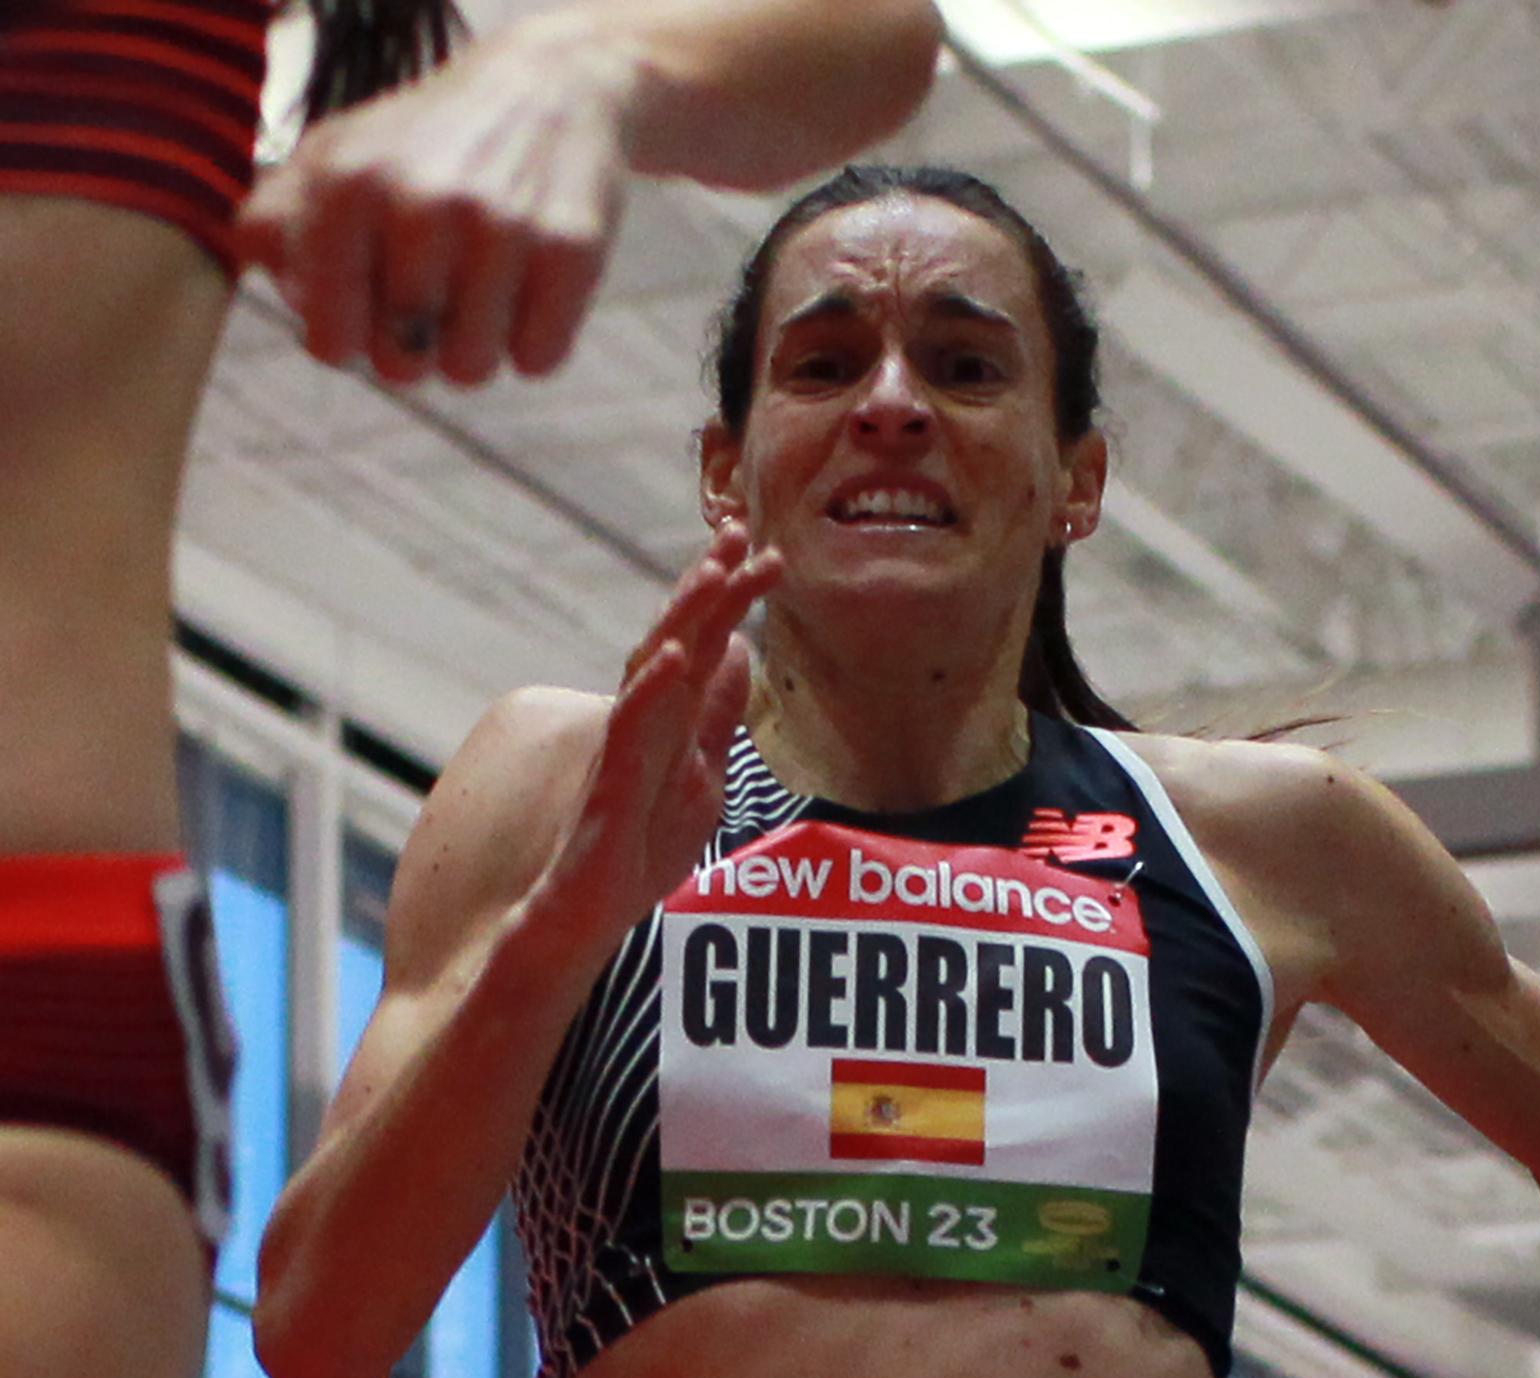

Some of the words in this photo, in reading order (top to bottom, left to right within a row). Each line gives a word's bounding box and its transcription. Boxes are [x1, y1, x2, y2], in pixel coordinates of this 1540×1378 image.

[697, 854, 832, 900] new
[850, 849, 1112, 933] balance
[682, 925, 1134, 1068] GUERRERO
[683, 1198, 911, 1244] BOSTON
[927, 1205, 998, 1251] 23
